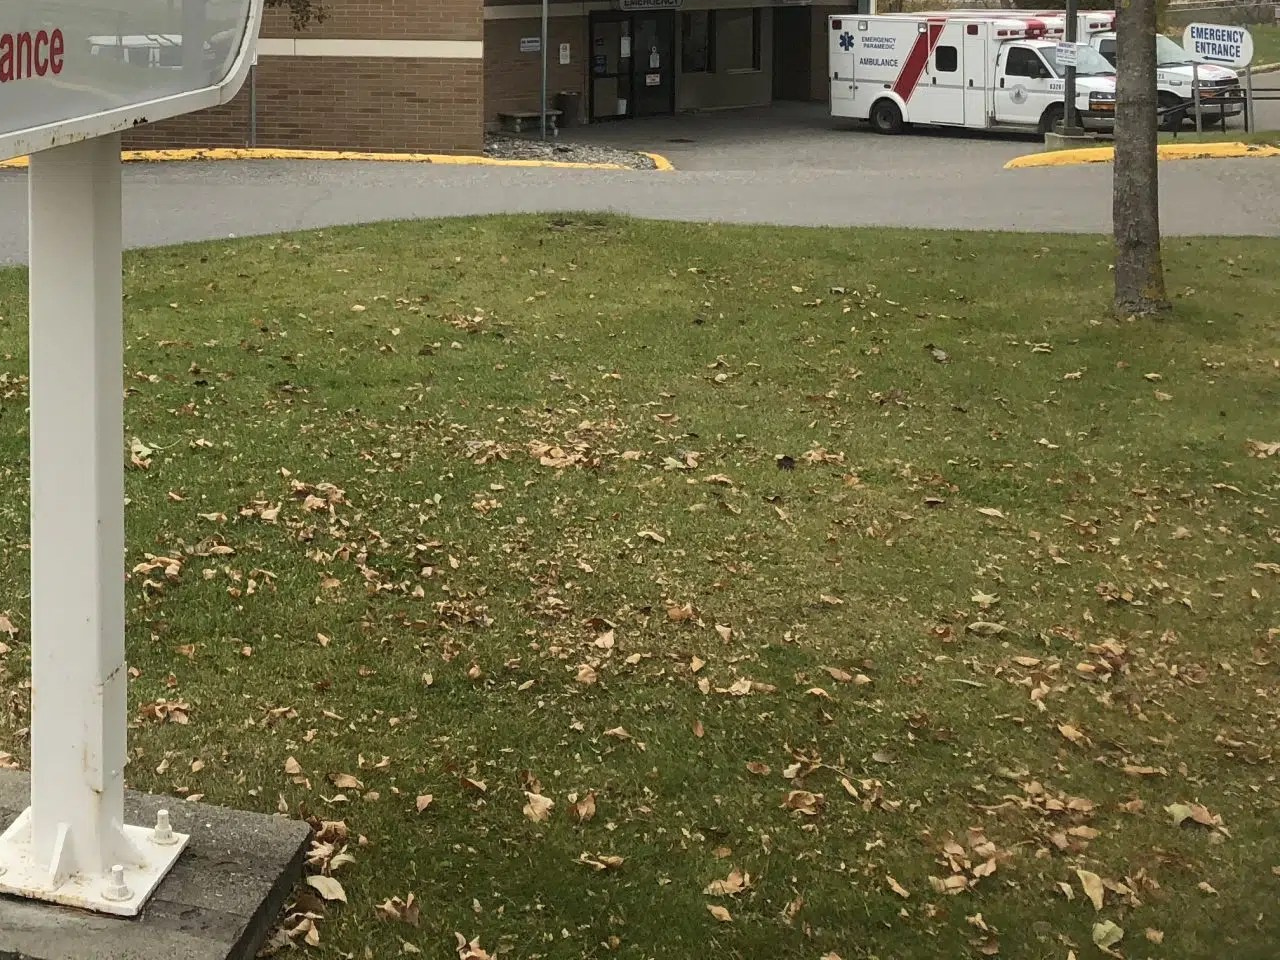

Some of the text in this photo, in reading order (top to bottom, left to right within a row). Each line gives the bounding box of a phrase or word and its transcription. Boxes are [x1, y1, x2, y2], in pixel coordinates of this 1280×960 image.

[1190, 26, 1245, 44] EMERGENCY
[1195, 41, 1241, 58] ENTRANCE
[859, 57, 899, 68] AMBULANCE
